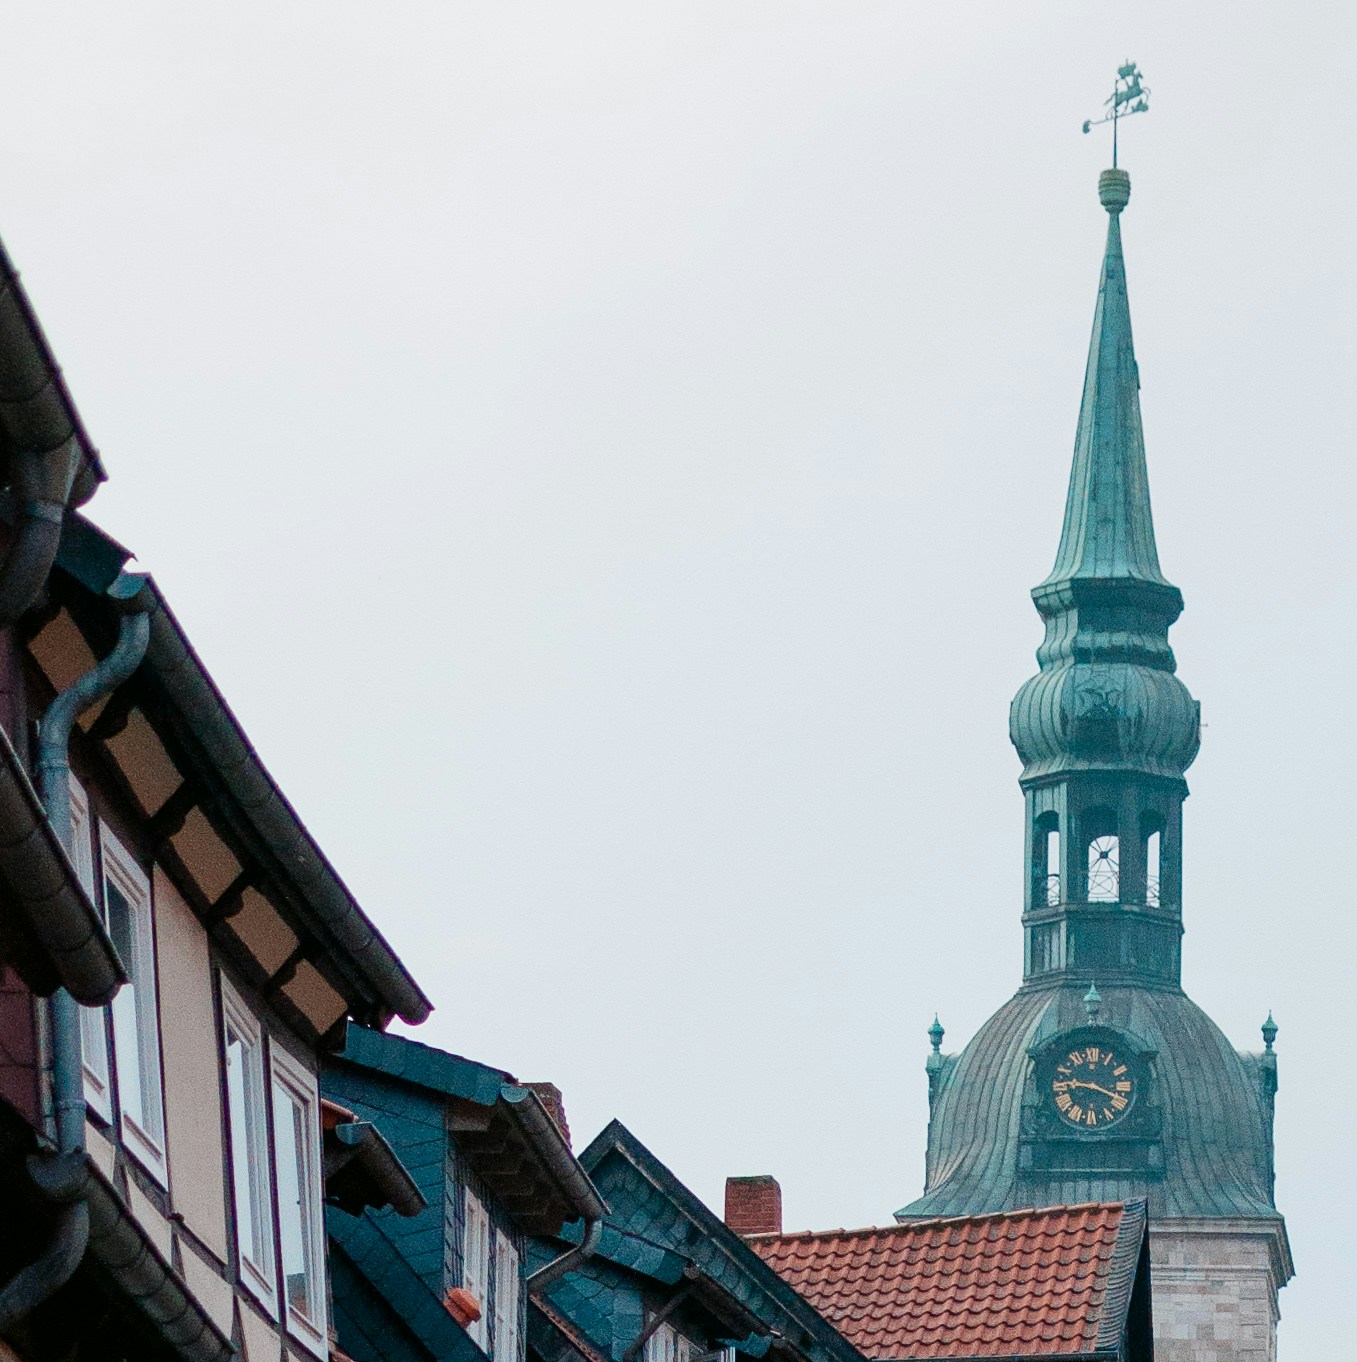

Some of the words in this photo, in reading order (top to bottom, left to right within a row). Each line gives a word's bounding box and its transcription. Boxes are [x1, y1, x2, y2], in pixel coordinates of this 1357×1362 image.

[1069, 1051, 1083, 1066] XI
[1086, 1048, 1099, 1062] XII
[1104, 1052, 1113, 1066] I
[1113, 1065, 1127, 1076] II
[1116, 1081, 1131, 1091] III
